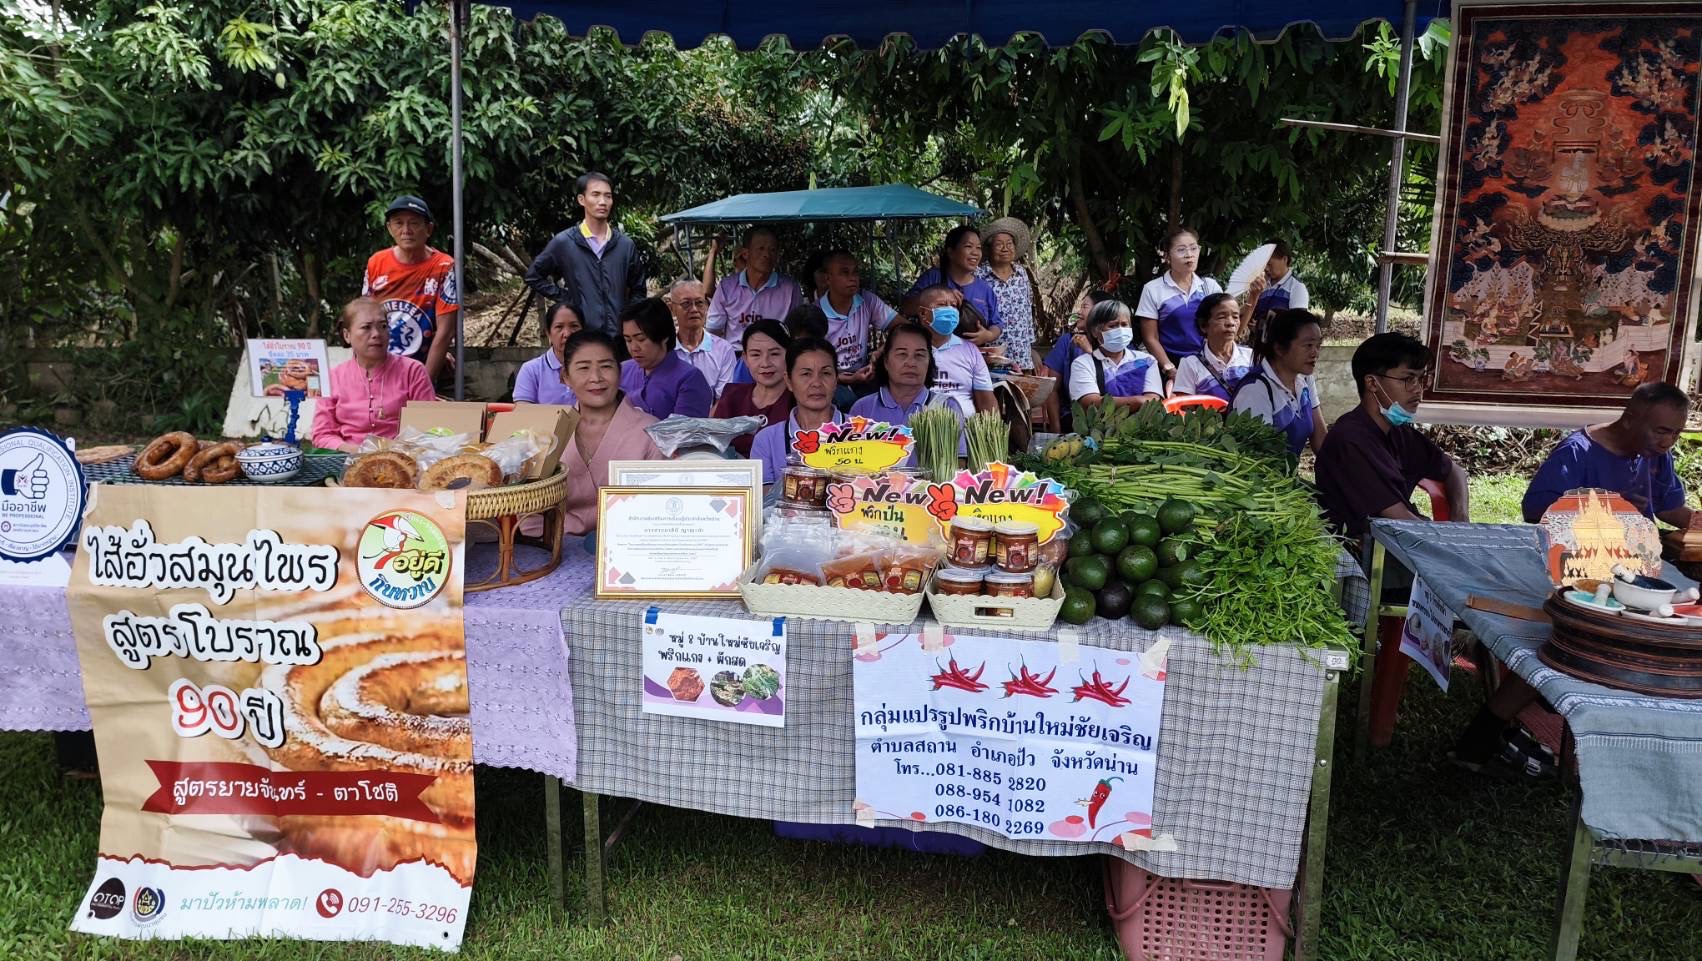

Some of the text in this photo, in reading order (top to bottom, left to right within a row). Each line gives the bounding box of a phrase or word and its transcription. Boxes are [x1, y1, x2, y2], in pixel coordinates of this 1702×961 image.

[383, 300, 423, 321] HELSEA
[837, 332, 857, 348] Join
[827, 428, 899, 443] New!
[964, 480, 1049, 504] New!
[1, 499, 47, 513] มืออาชีพ
[87, 528, 329, 598] ไส้อั่วสมุนไพร
[393, 548, 445, 581] อยู่ดี
[111, 611, 312, 662] สูตรโบราณ
[669, 631, 684, 648] หมู่
[658, 647, 703, 663] พริกแกง
[716, 651, 746, 667] ผักสด
[177, 684, 238, 731] 90
[860, 702, 1152, 751] กลุ่มแปรรูปพริกบ้านใหม่ชัยเจริญ
[870, 737, 1138, 776] ตำบลสถาน อำเภอปัว จังหวัดน่าน
[173, 776, 306, 806] สูตรยายจันทร์
[334, 781, 399, 803] ตาโชติ
[1008, 777, 1046, 792] 2820
[935, 783, 1045, 814] 088-954 1082
[935, 804, 1044, 835] 086-180 2269
[93, 892, 125, 906] OTOP
[179, 889, 308, 912] มาปัวห้ามพลาด!
[347, 896, 457, 924] 091-255-3296
